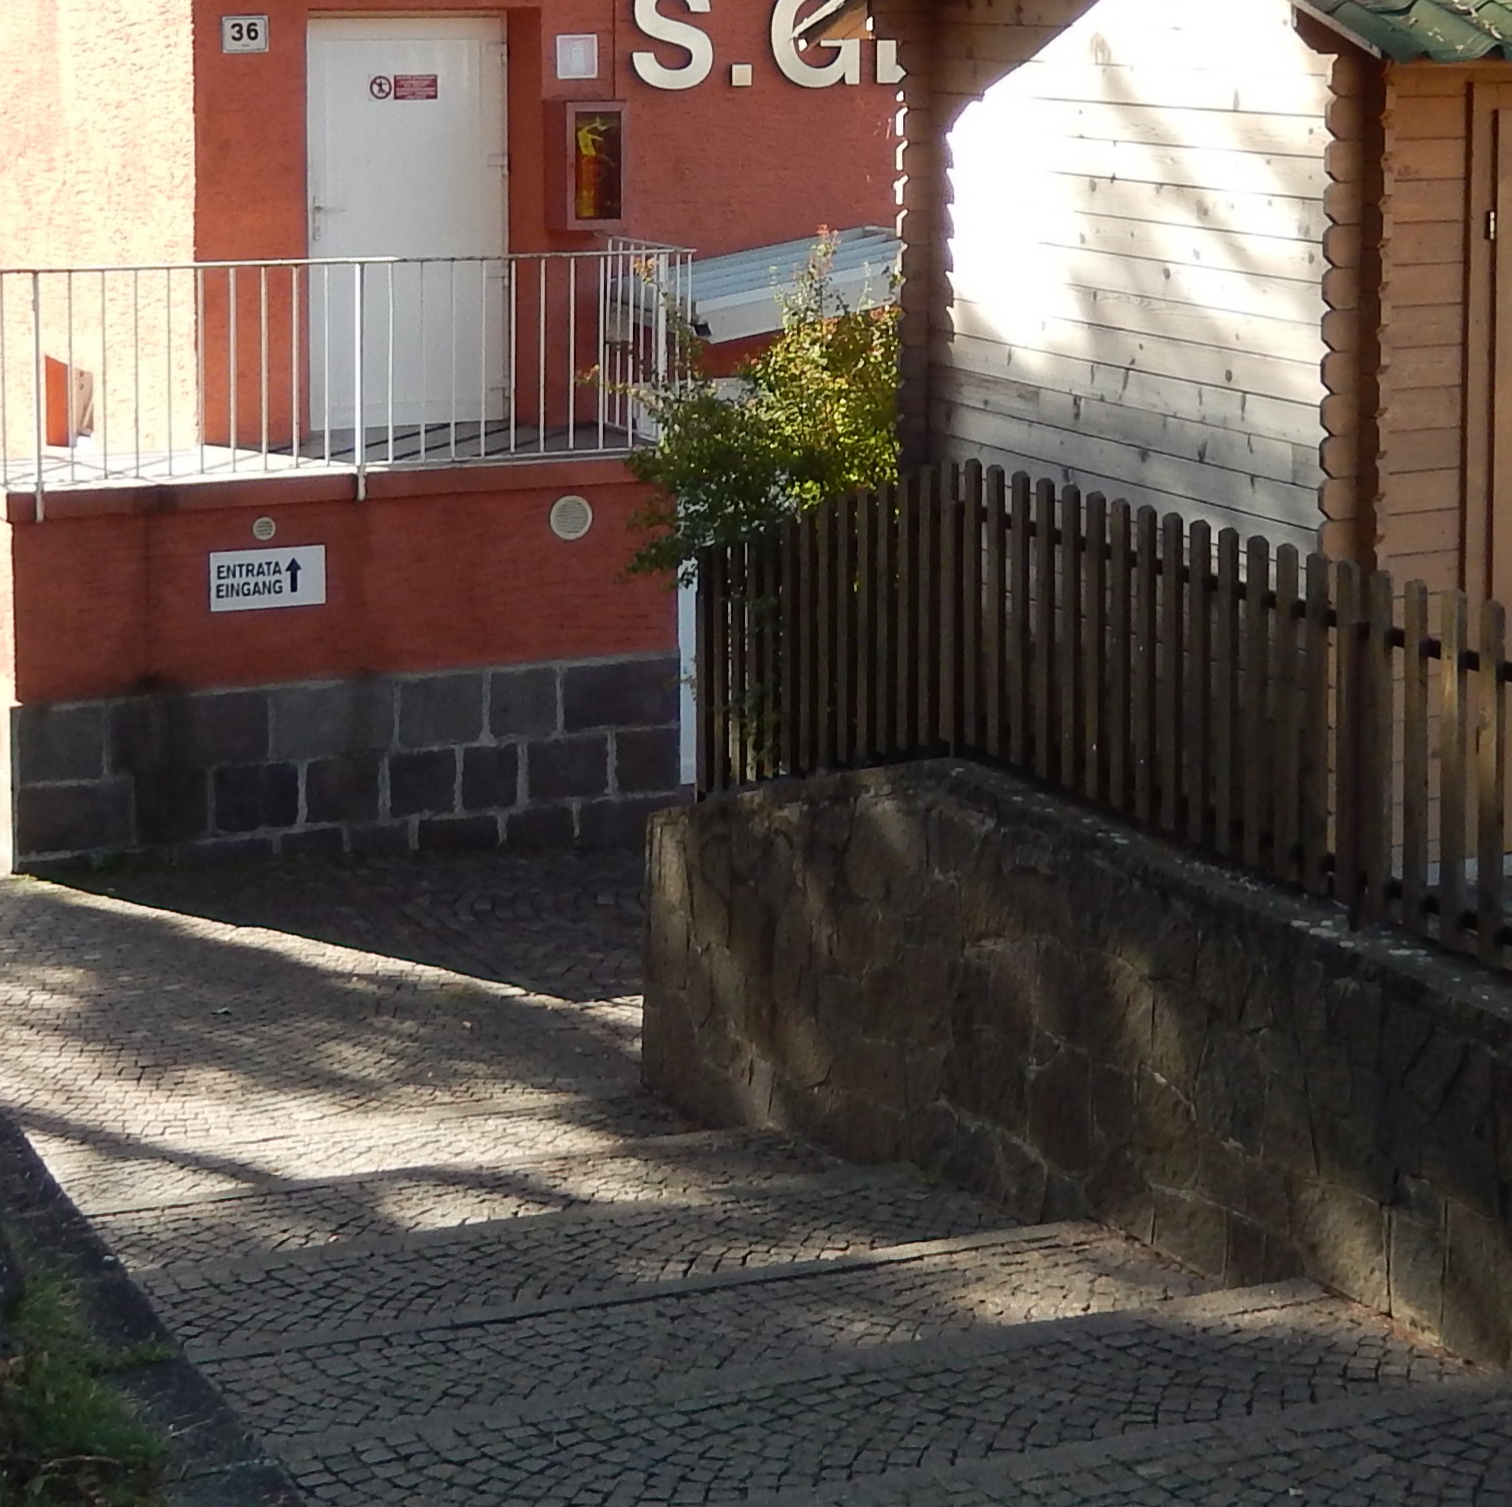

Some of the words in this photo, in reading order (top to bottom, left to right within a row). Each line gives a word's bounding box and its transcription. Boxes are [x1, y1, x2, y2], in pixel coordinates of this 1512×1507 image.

[230, 22, 259, 42] 36
[216, 561, 282, 580] ENTRATA
[216, 579, 283, 599] EINGANG
